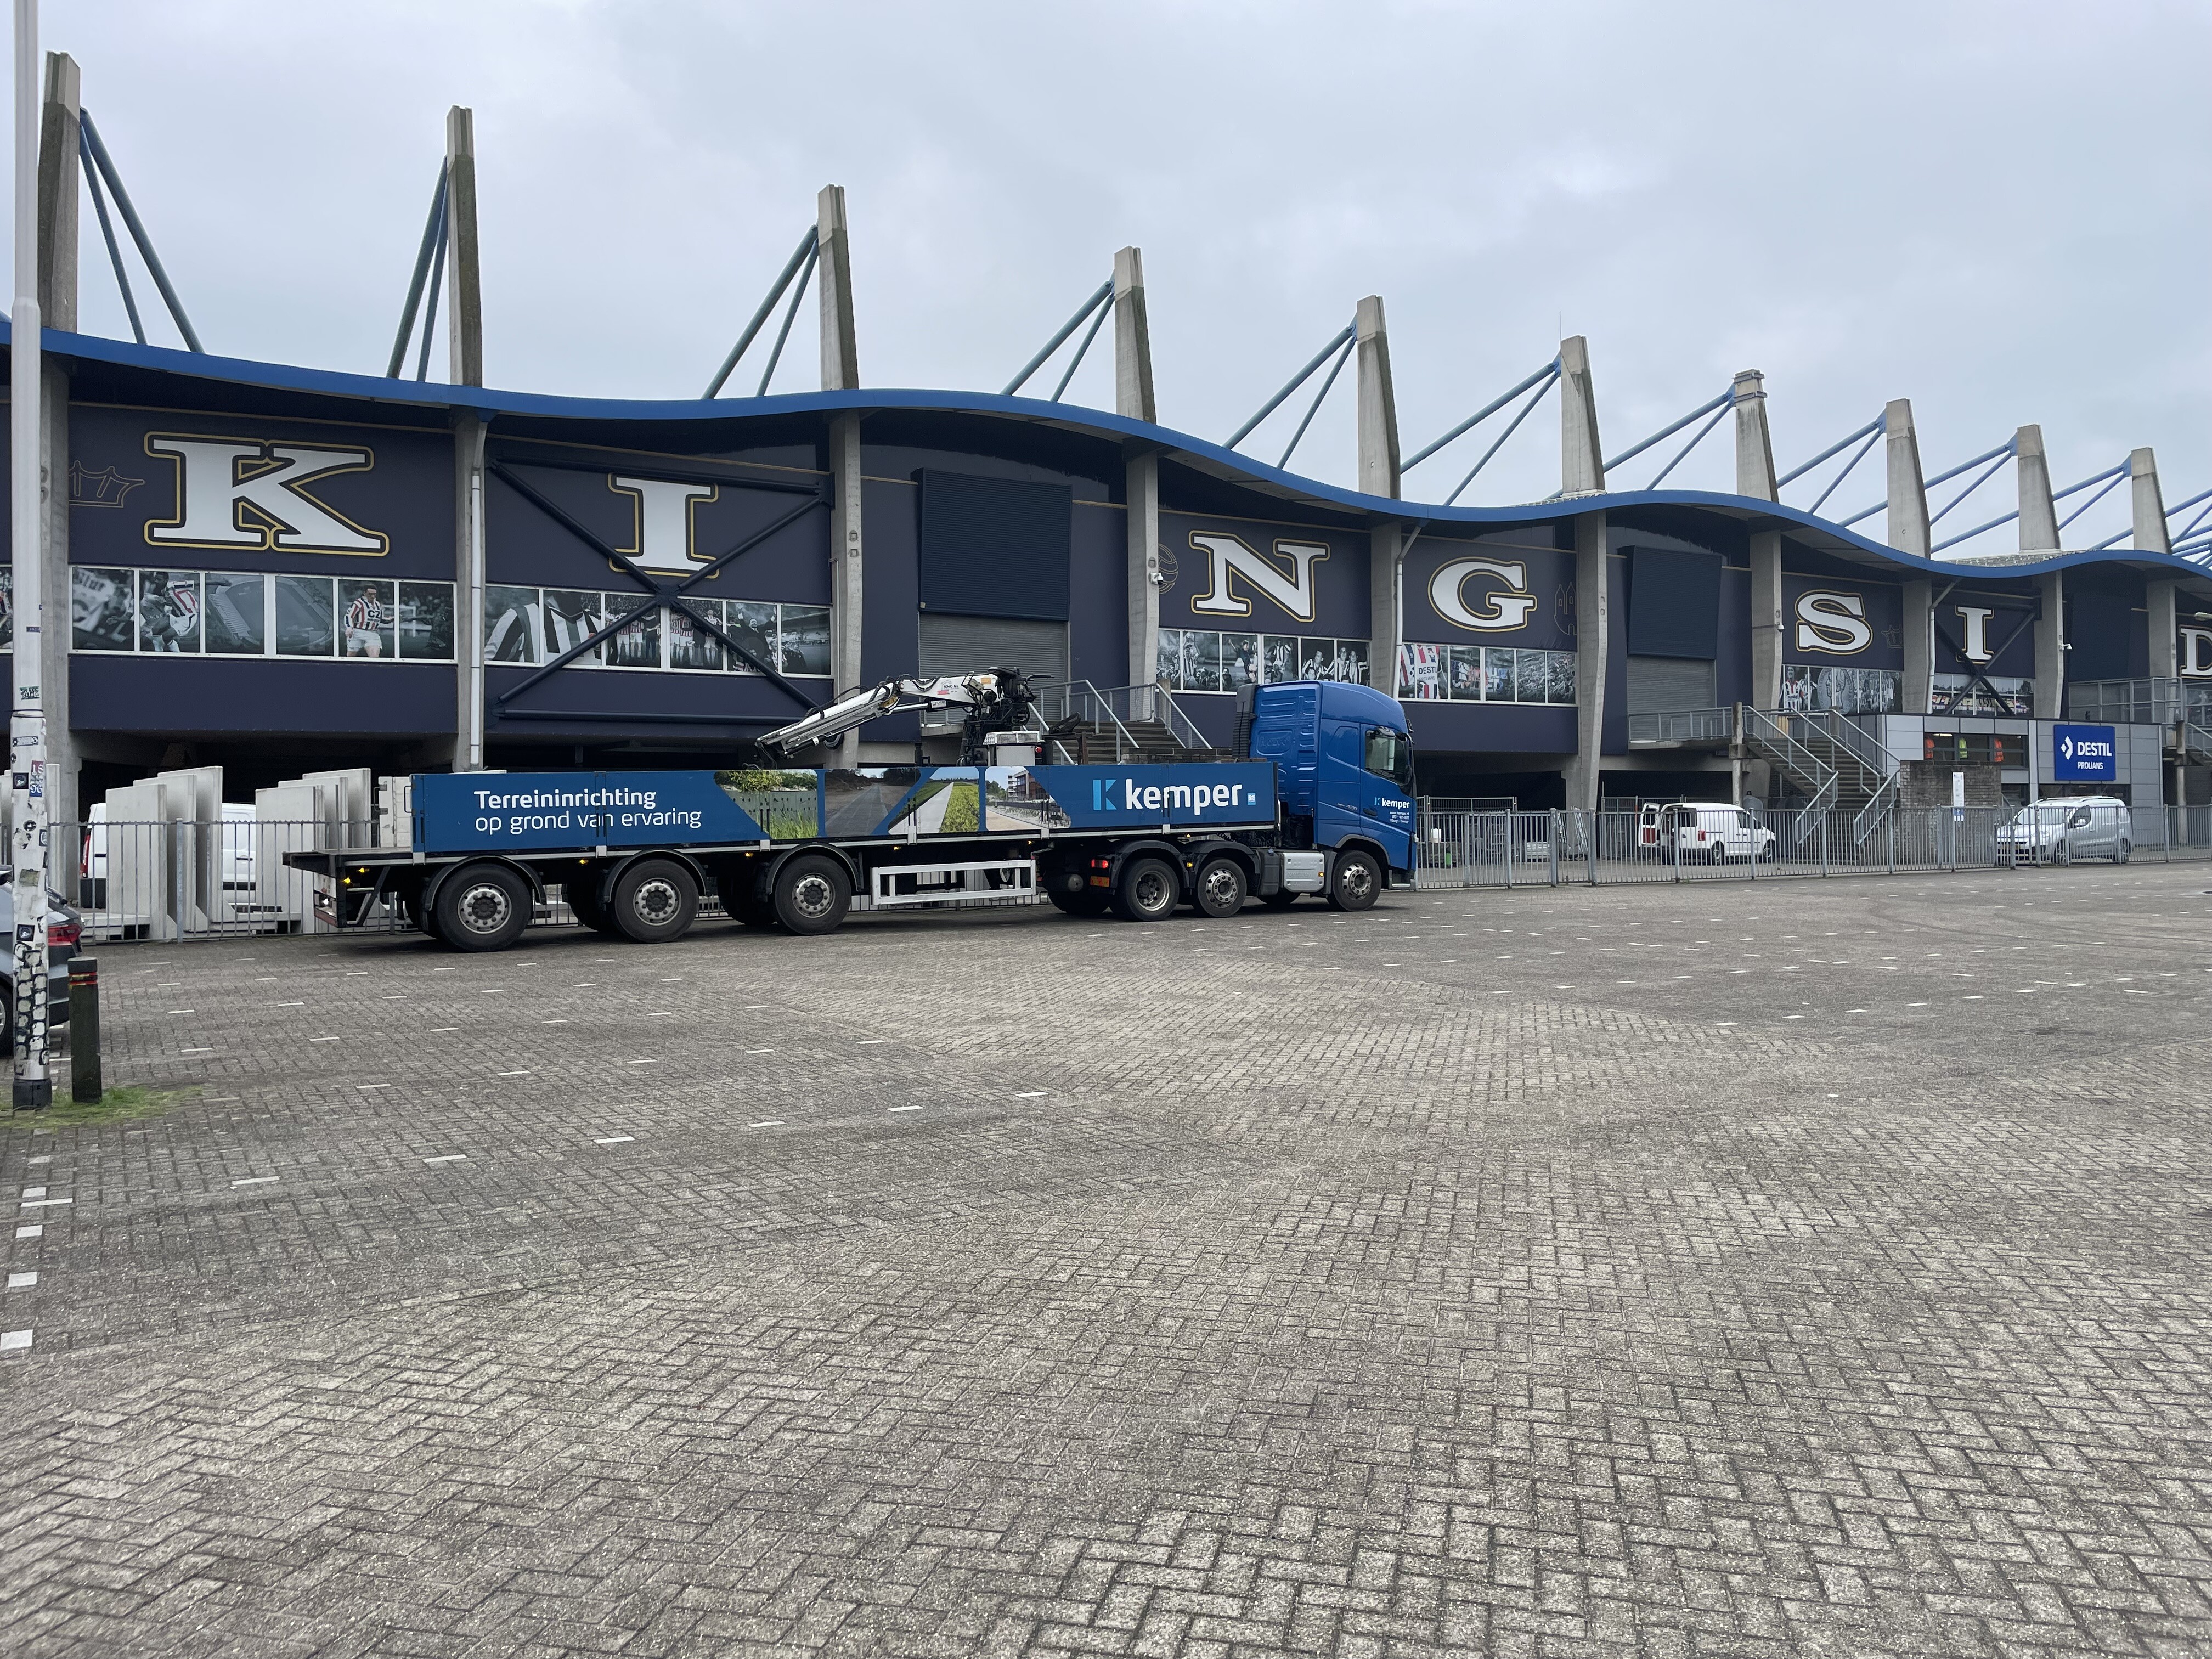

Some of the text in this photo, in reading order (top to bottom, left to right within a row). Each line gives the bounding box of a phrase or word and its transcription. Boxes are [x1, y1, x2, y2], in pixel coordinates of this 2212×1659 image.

[145, 432, 389, 556] K
[1189, 531, 1330, 622] N
[1427, 557, 1537, 632] G
[1795, 590, 1872, 654] S
[2078, 742, 2112, 757] DESTIL
[2078, 761, 2104, 770] PROLIANS
[473, 788, 657, 810] Terreininrichting
[1125, 778, 1243, 816] kemper
[1382, 797, 1410, 810] kemper
[475, 808, 702, 836] op grond van ervaring
